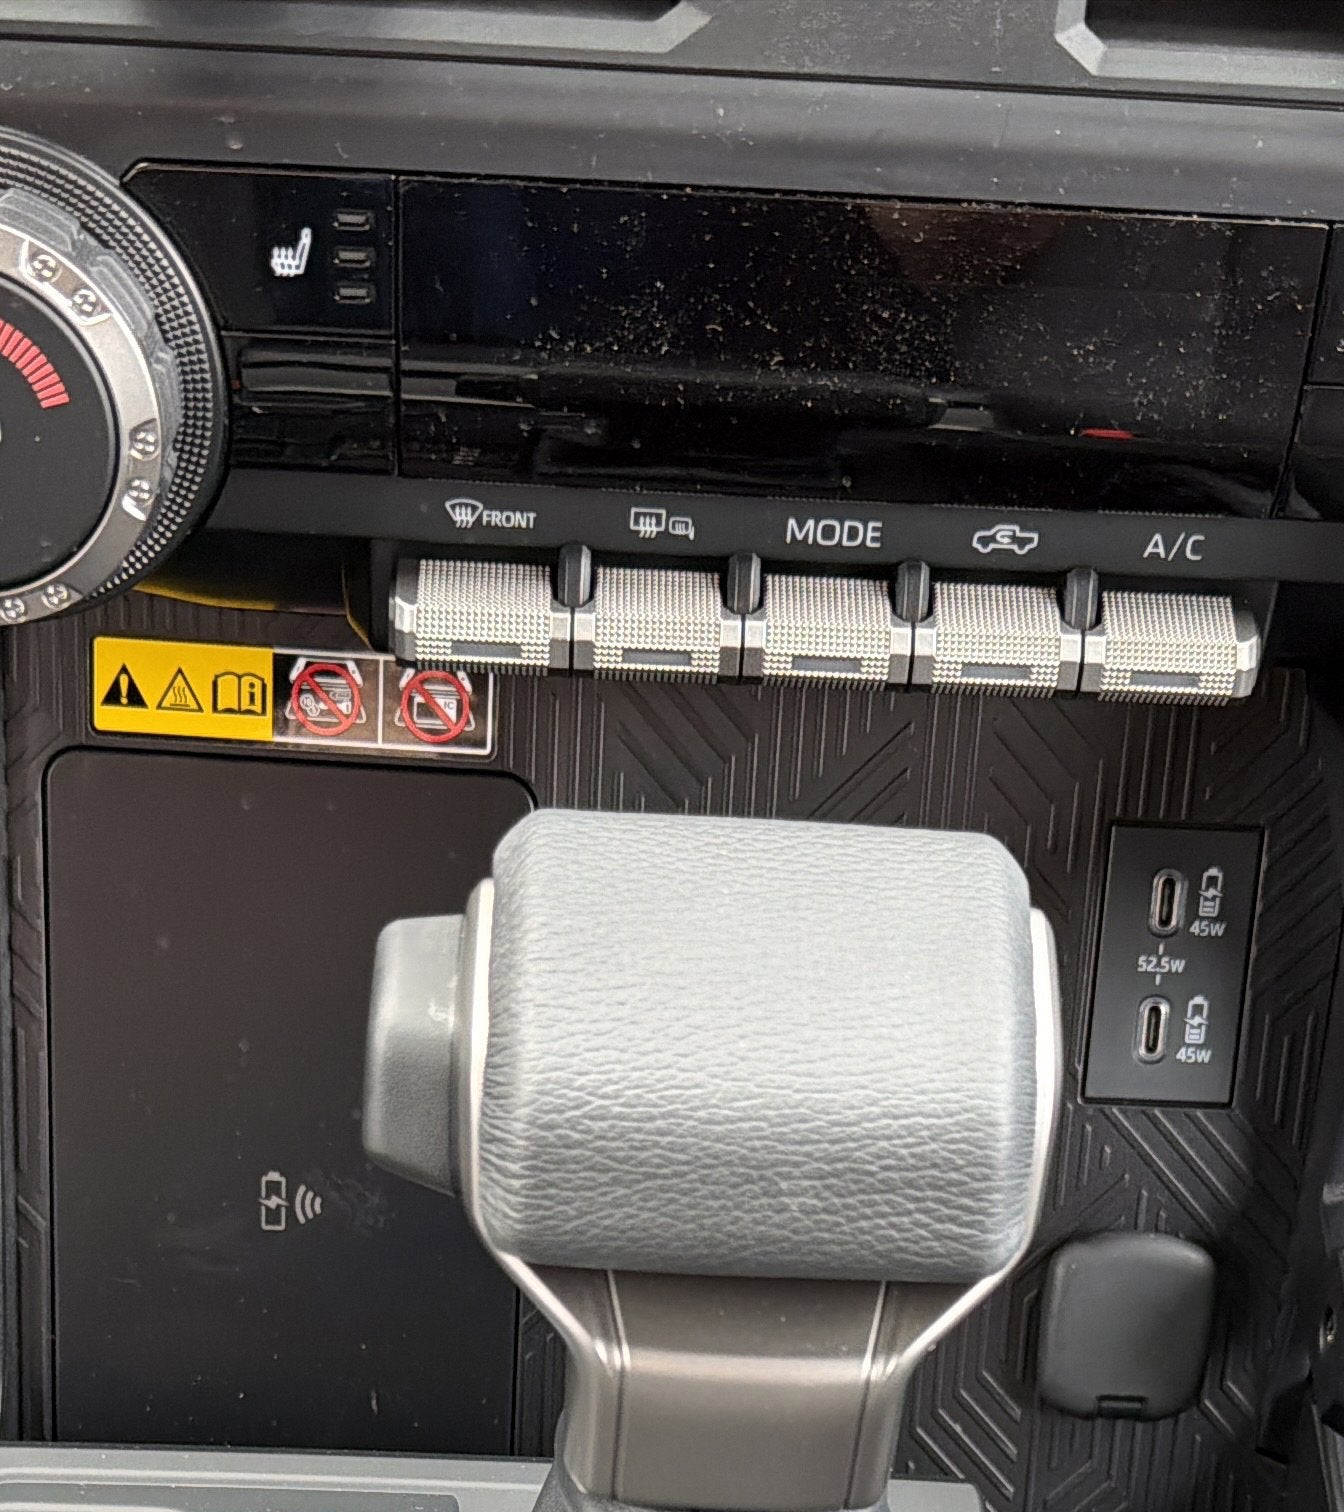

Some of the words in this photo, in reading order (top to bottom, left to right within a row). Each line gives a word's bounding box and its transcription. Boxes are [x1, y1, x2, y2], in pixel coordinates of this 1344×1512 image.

[482, 510, 537, 530] FRONT
[785, 517, 884, 549] MODE
[1142, 531, 1205, 561] A/C
[443, 700, 455, 711] IC
[1189, 919, 1228, 937] 45W
[1137, 955, 1186, 973] 52.5W
[1176, 1046, 1212, 1064] 45W
